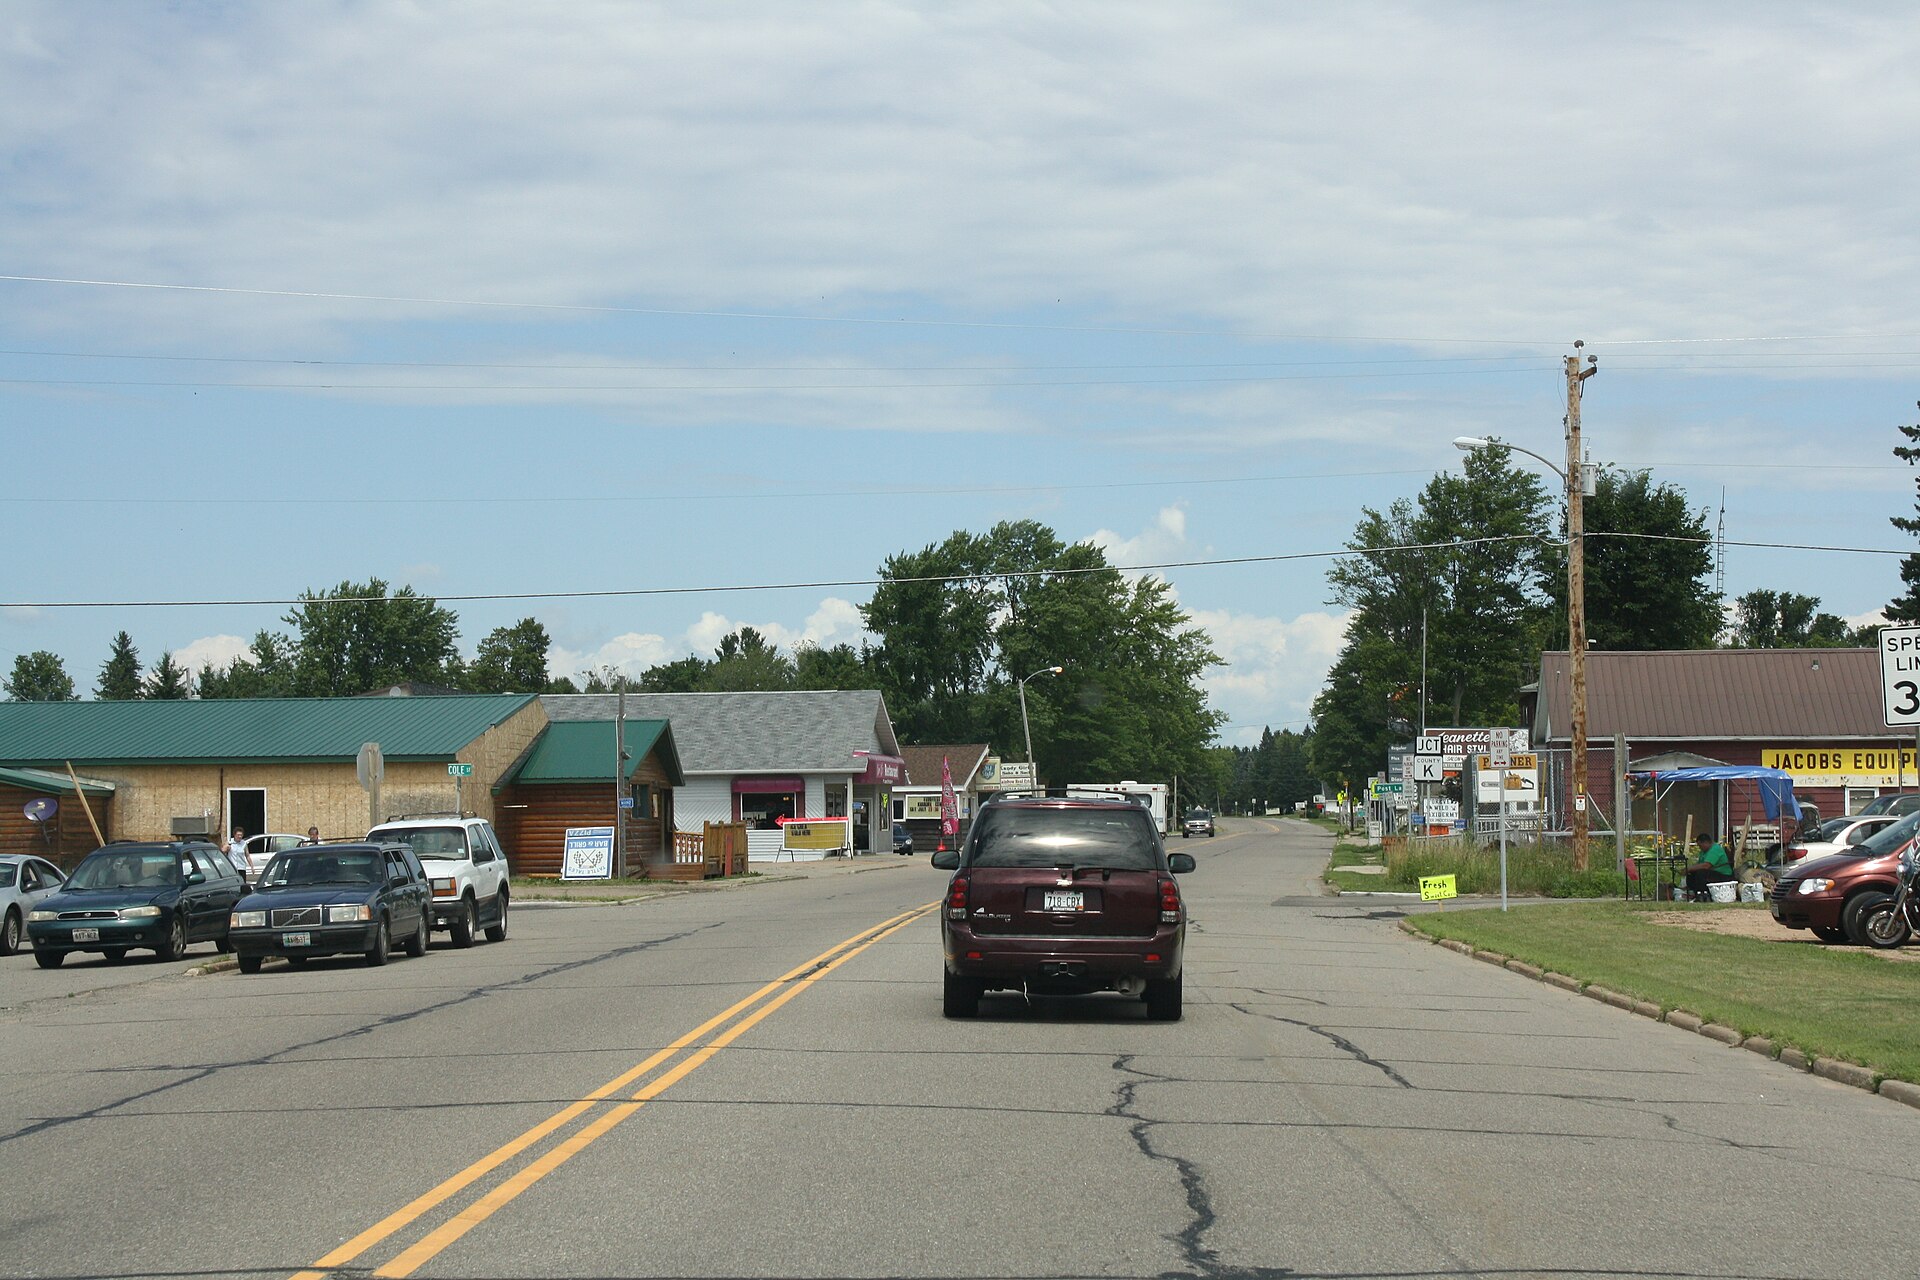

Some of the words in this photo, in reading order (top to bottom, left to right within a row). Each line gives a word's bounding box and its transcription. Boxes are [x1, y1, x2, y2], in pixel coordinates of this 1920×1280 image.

[1439, 731, 1490, 744] eanette
[1495, 731, 1504, 739] NO
[1418, 739, 1440, 751] JCT
[1491, 740, 1508, 748] PARKING
[1483, 757, 1532, 766] PNER
[1771, 753, 1842, 769] JACOBS
[1854, 752, 1917, 769] EQUIP
[448, 765, 465, 775] COLE
[1423, 764, 1434, 777] K
[595, 840, 609, 848] BAR
[1422, 880, 1447, 889] Fresh
